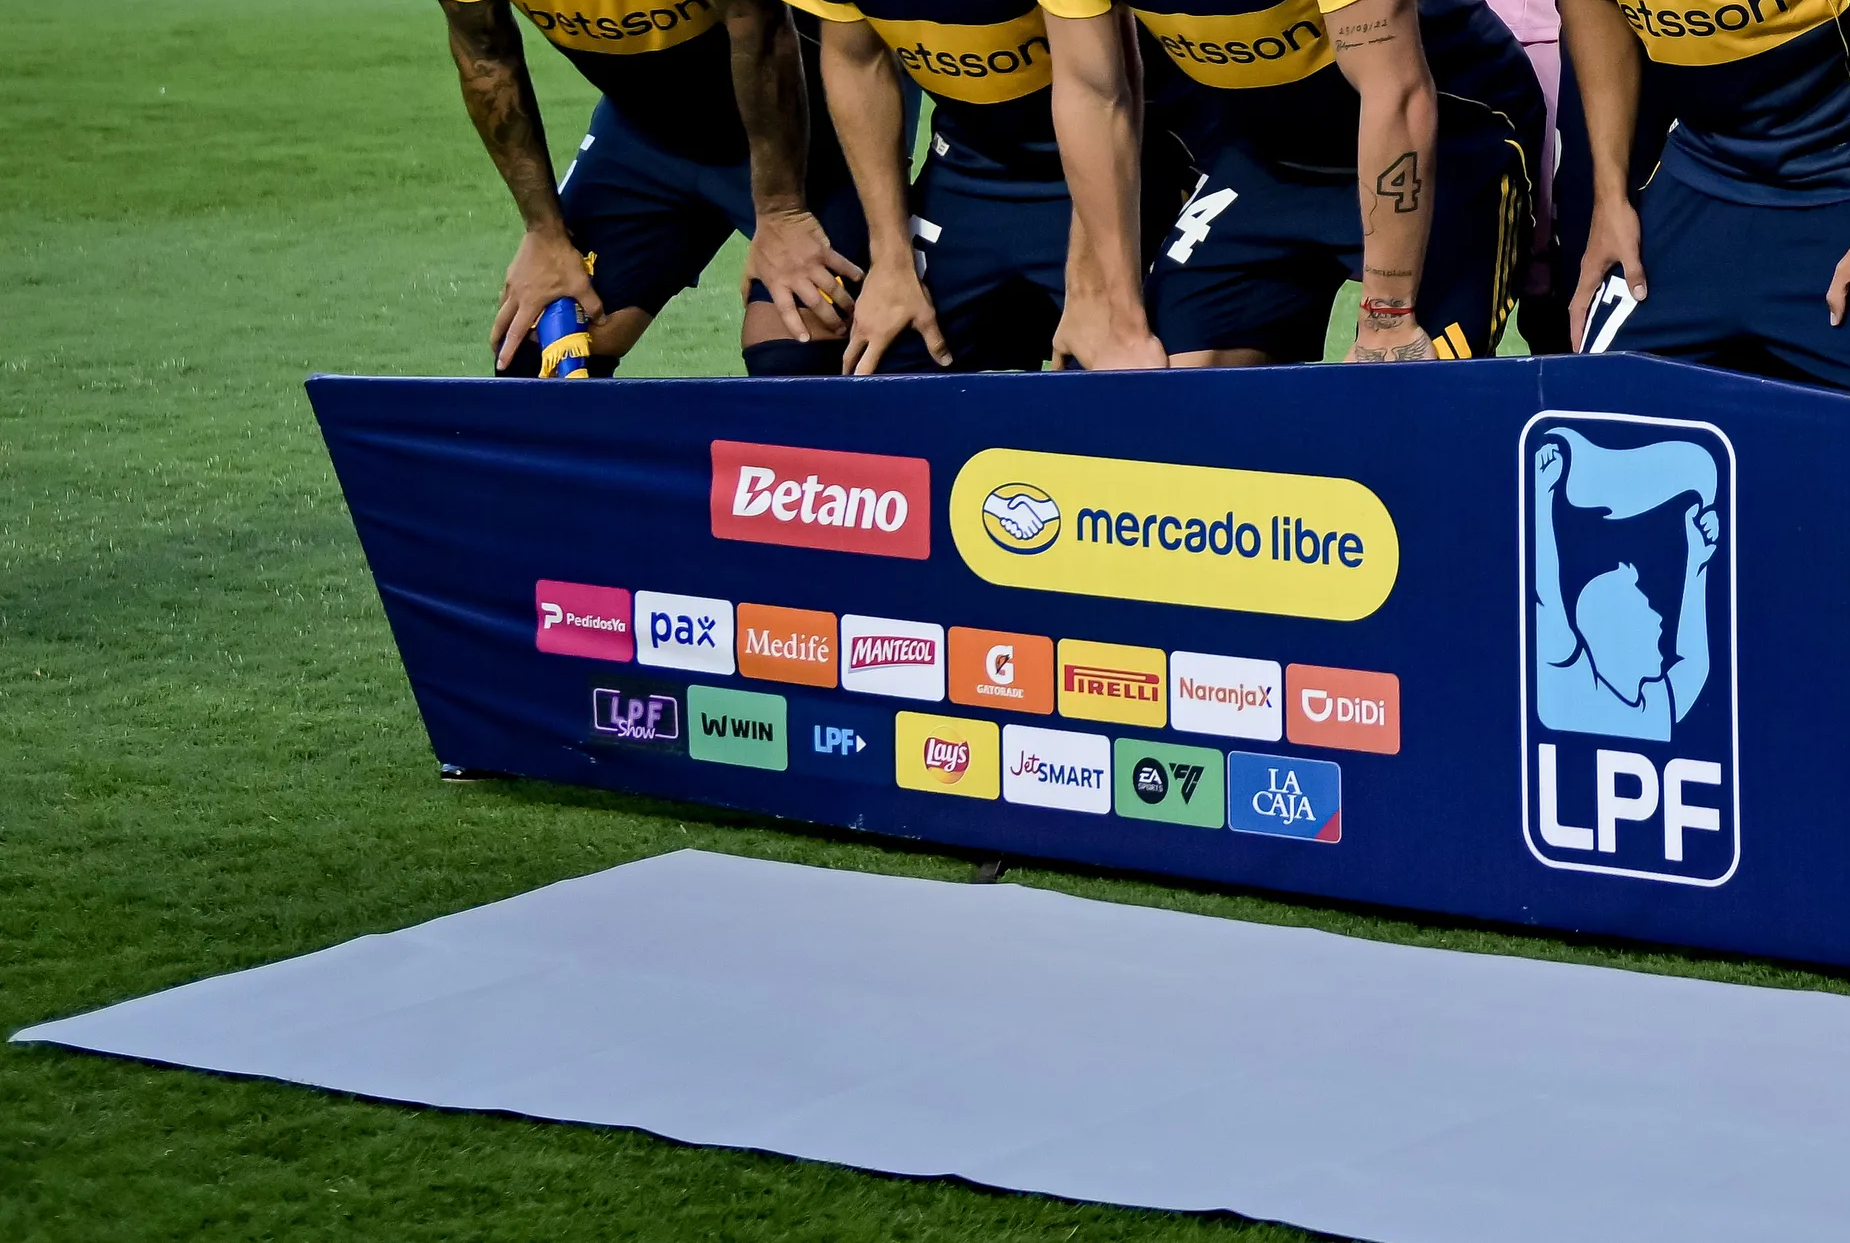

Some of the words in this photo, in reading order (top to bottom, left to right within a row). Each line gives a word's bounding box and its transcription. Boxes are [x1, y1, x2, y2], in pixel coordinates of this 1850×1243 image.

[1376, 150, 1422, 213] 4
[731, 464, 909, 533] Betano
[1076, 506, 1262, 559] mercado
[1271, 515, 1365, 569] libre
[565, 612, 627, 634] PedidosYa
[650, 611, 717, 649] pax
[744, 628, 831, 664] Medifé
[851, 638, 933, 666] MANTECOL
[976, 683, 1024, 699] GATORADE
[1063, 664, 1160, 702] PIRELLI
[609, 691, 664, 727] LPF
[1337, 697, 1386, 727] DiDi
[617, 719, 656, 741] Show
[730, 718, 774, 743] WIN
[814, 724, 854, 756] LPF
[926, 736, 970, 768] Lay's
[1009, 749, 1105, 790] JetSMART
[1138, 766, 1163, 784] EA
[1267, 767, 1303, 795] LA
[1251, 790, 1317, 825] CAJA
[1538, 743, 1722, 862] LPF
